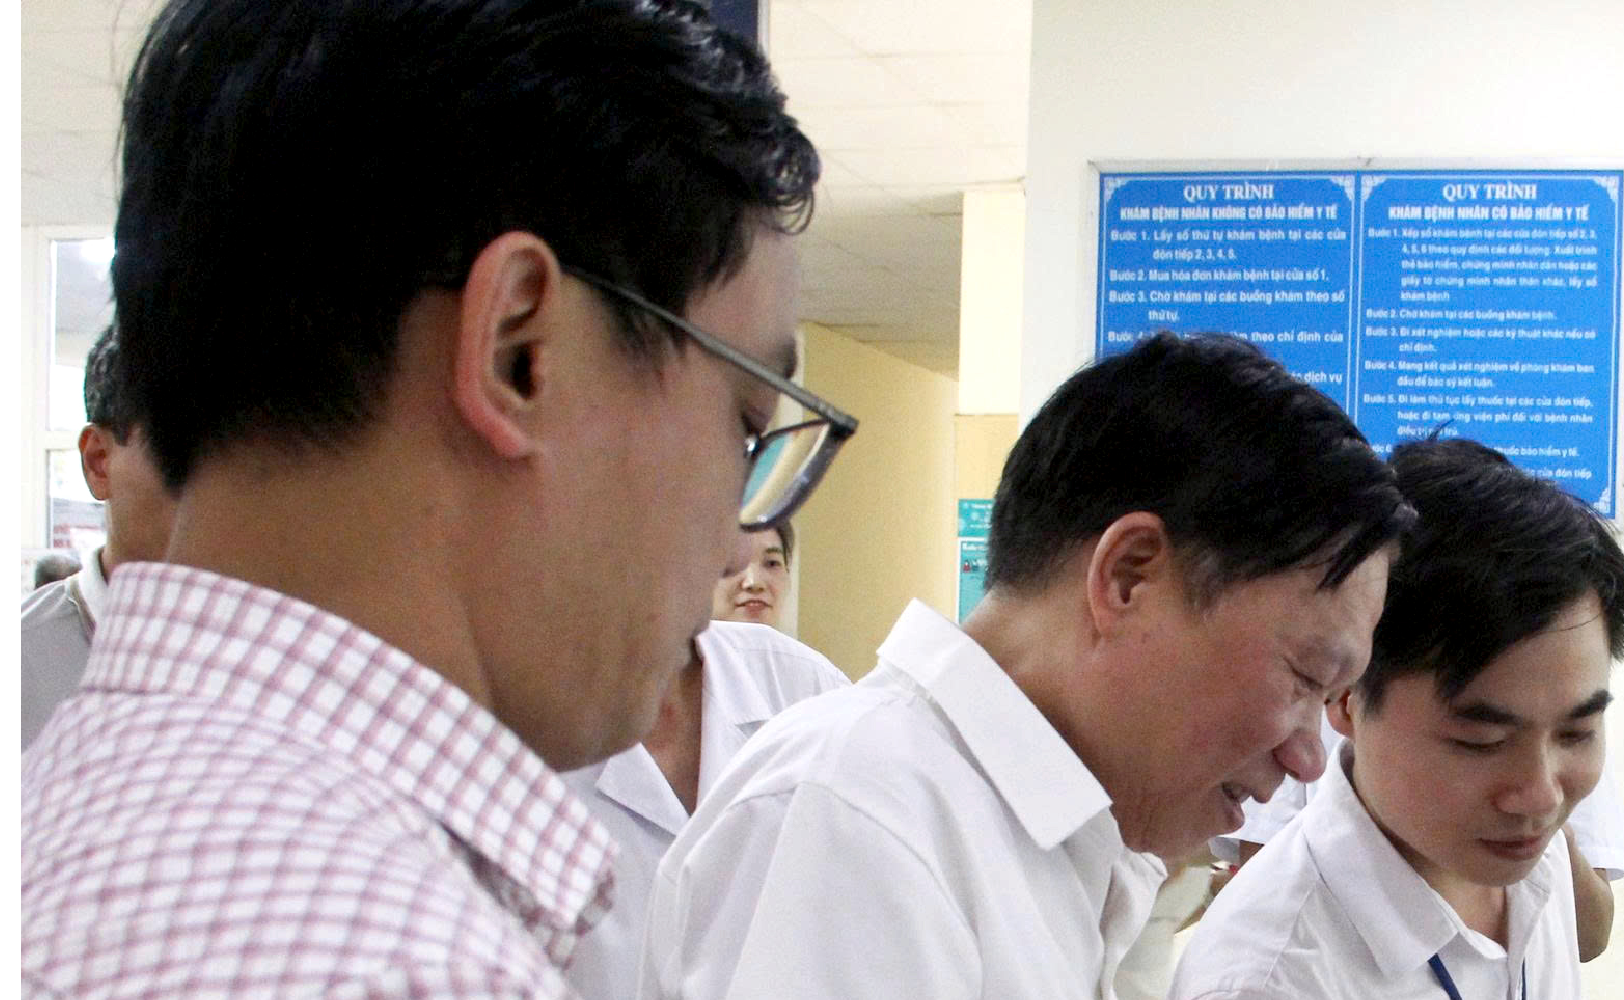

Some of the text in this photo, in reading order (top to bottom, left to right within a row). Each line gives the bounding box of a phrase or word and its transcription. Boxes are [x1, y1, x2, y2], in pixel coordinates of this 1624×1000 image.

[1183, 181, 1275, 203] QUY TRÌNH
[1442, 180, 1538, 203] QUY TRÌNH
